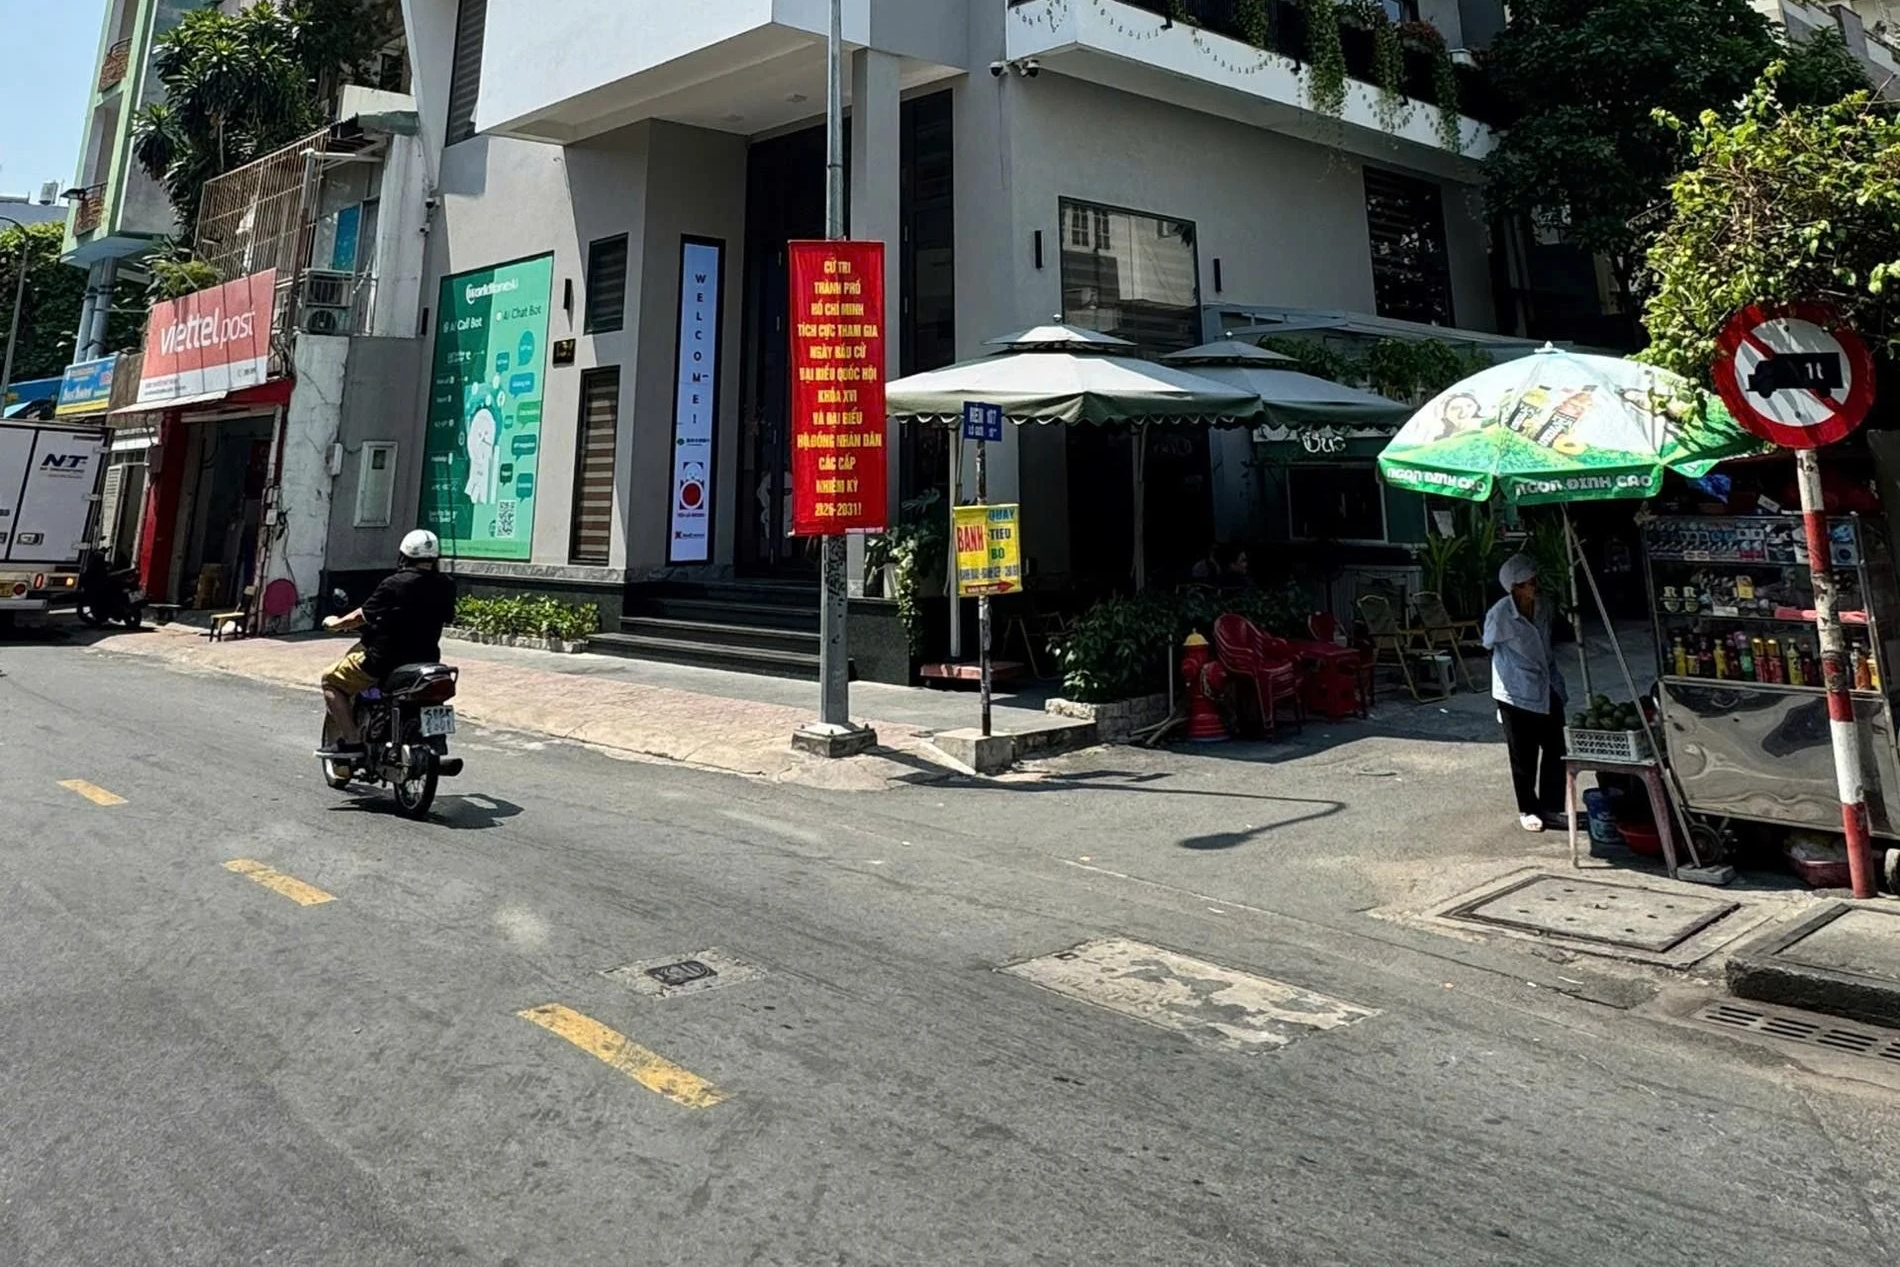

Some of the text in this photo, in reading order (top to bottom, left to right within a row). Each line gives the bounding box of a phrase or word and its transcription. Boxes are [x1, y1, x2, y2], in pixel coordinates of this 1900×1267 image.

[838, 261, 851, 274] TRI
[814, 278, 861, 294] THÀNH PHỐ
[825, 300, 840, 315] CHÍ
[841, 303, 864, 315] MINH
[471, 316, 483, 329] Bot
[798, 321, 817, 337] TÍCH
[838, 324, 861, 337] THAM
[863, 324, 878, 337] GIA
[810, 343, 832, 359] NGÀY
[837, 363, 861, 382] QUỐC
[1805, 362, 1824, 380] 1t
[842, 389, 857, 403] XVI
[836, 431, 861, 447] NHÂN
[863, 431, 882, 447] DÂN
[818, 453, 856, 471] CÁC CẤP
[846, 476, 858, 493] KỲ
[1616, 474, 1653, 488] CAO
